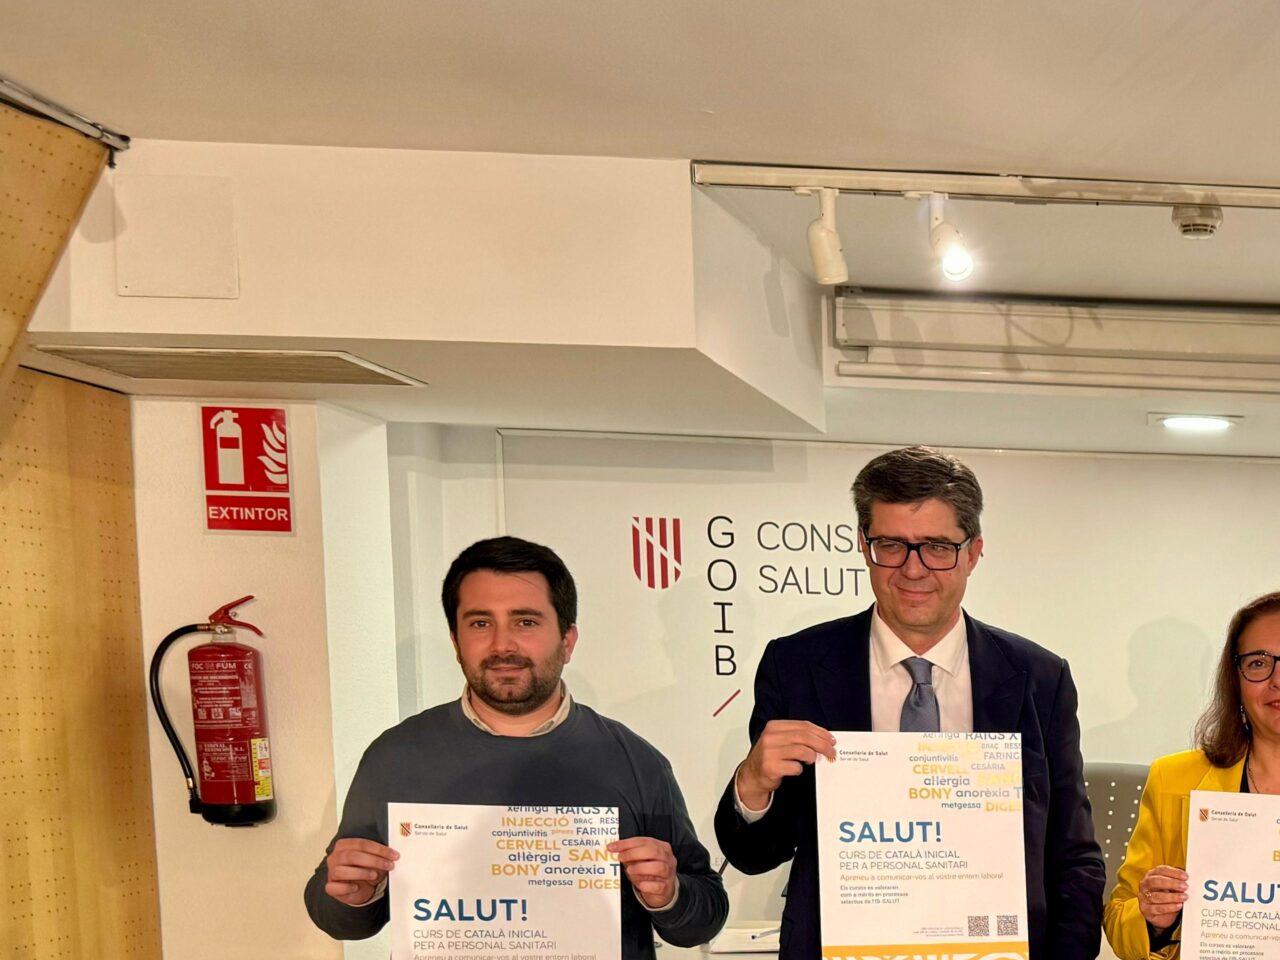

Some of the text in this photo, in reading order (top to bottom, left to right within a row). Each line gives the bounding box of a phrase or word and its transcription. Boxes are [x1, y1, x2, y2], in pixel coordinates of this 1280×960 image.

[208, 506, 289, 521] EXTINTOR
[757, 521, 862, 553] CONS
[758, 564, 866, 597] SALUT
[909, 754, 959, 763] conjuntivitis
[909, 787, 952, 799] BONY
[942, 801, 981, 809] metgessa
[502, 817, 569, 827] INJECCIÓ
[492, 829, 548, 838] conjuntivitis
[839, 821, 942, 843] SALUT!
[496, 839, 561, 851] CERVELL
[562, 838, 600, 847] CESÀRIA
[839, 849, 960, 859] CURS DE CATALÀ INICIAL
[491, 863, 606, 876] BONY anorèxia
[839, 861, 968, 870] PER A PERSONAL SANITARI
[528, 879, 573, 887] metgessa
[413, 898, 528, 922] SALUT!
[1201, 909, 1227, 918] CURS
[1229, 910, 1242, 918] DE
[1245, 911, 1280, 920] CATALÀ
[1201, 919, 1219, 928] PER
[1221, 920, 1228, 928] A
[1230, 921, 1280, 931] PERSONAL
[413, 928, 548, 939] CURS DE CATALÀ INICIAL
[414, 941, 557, 950] PER A PERSONAL SANITARI
